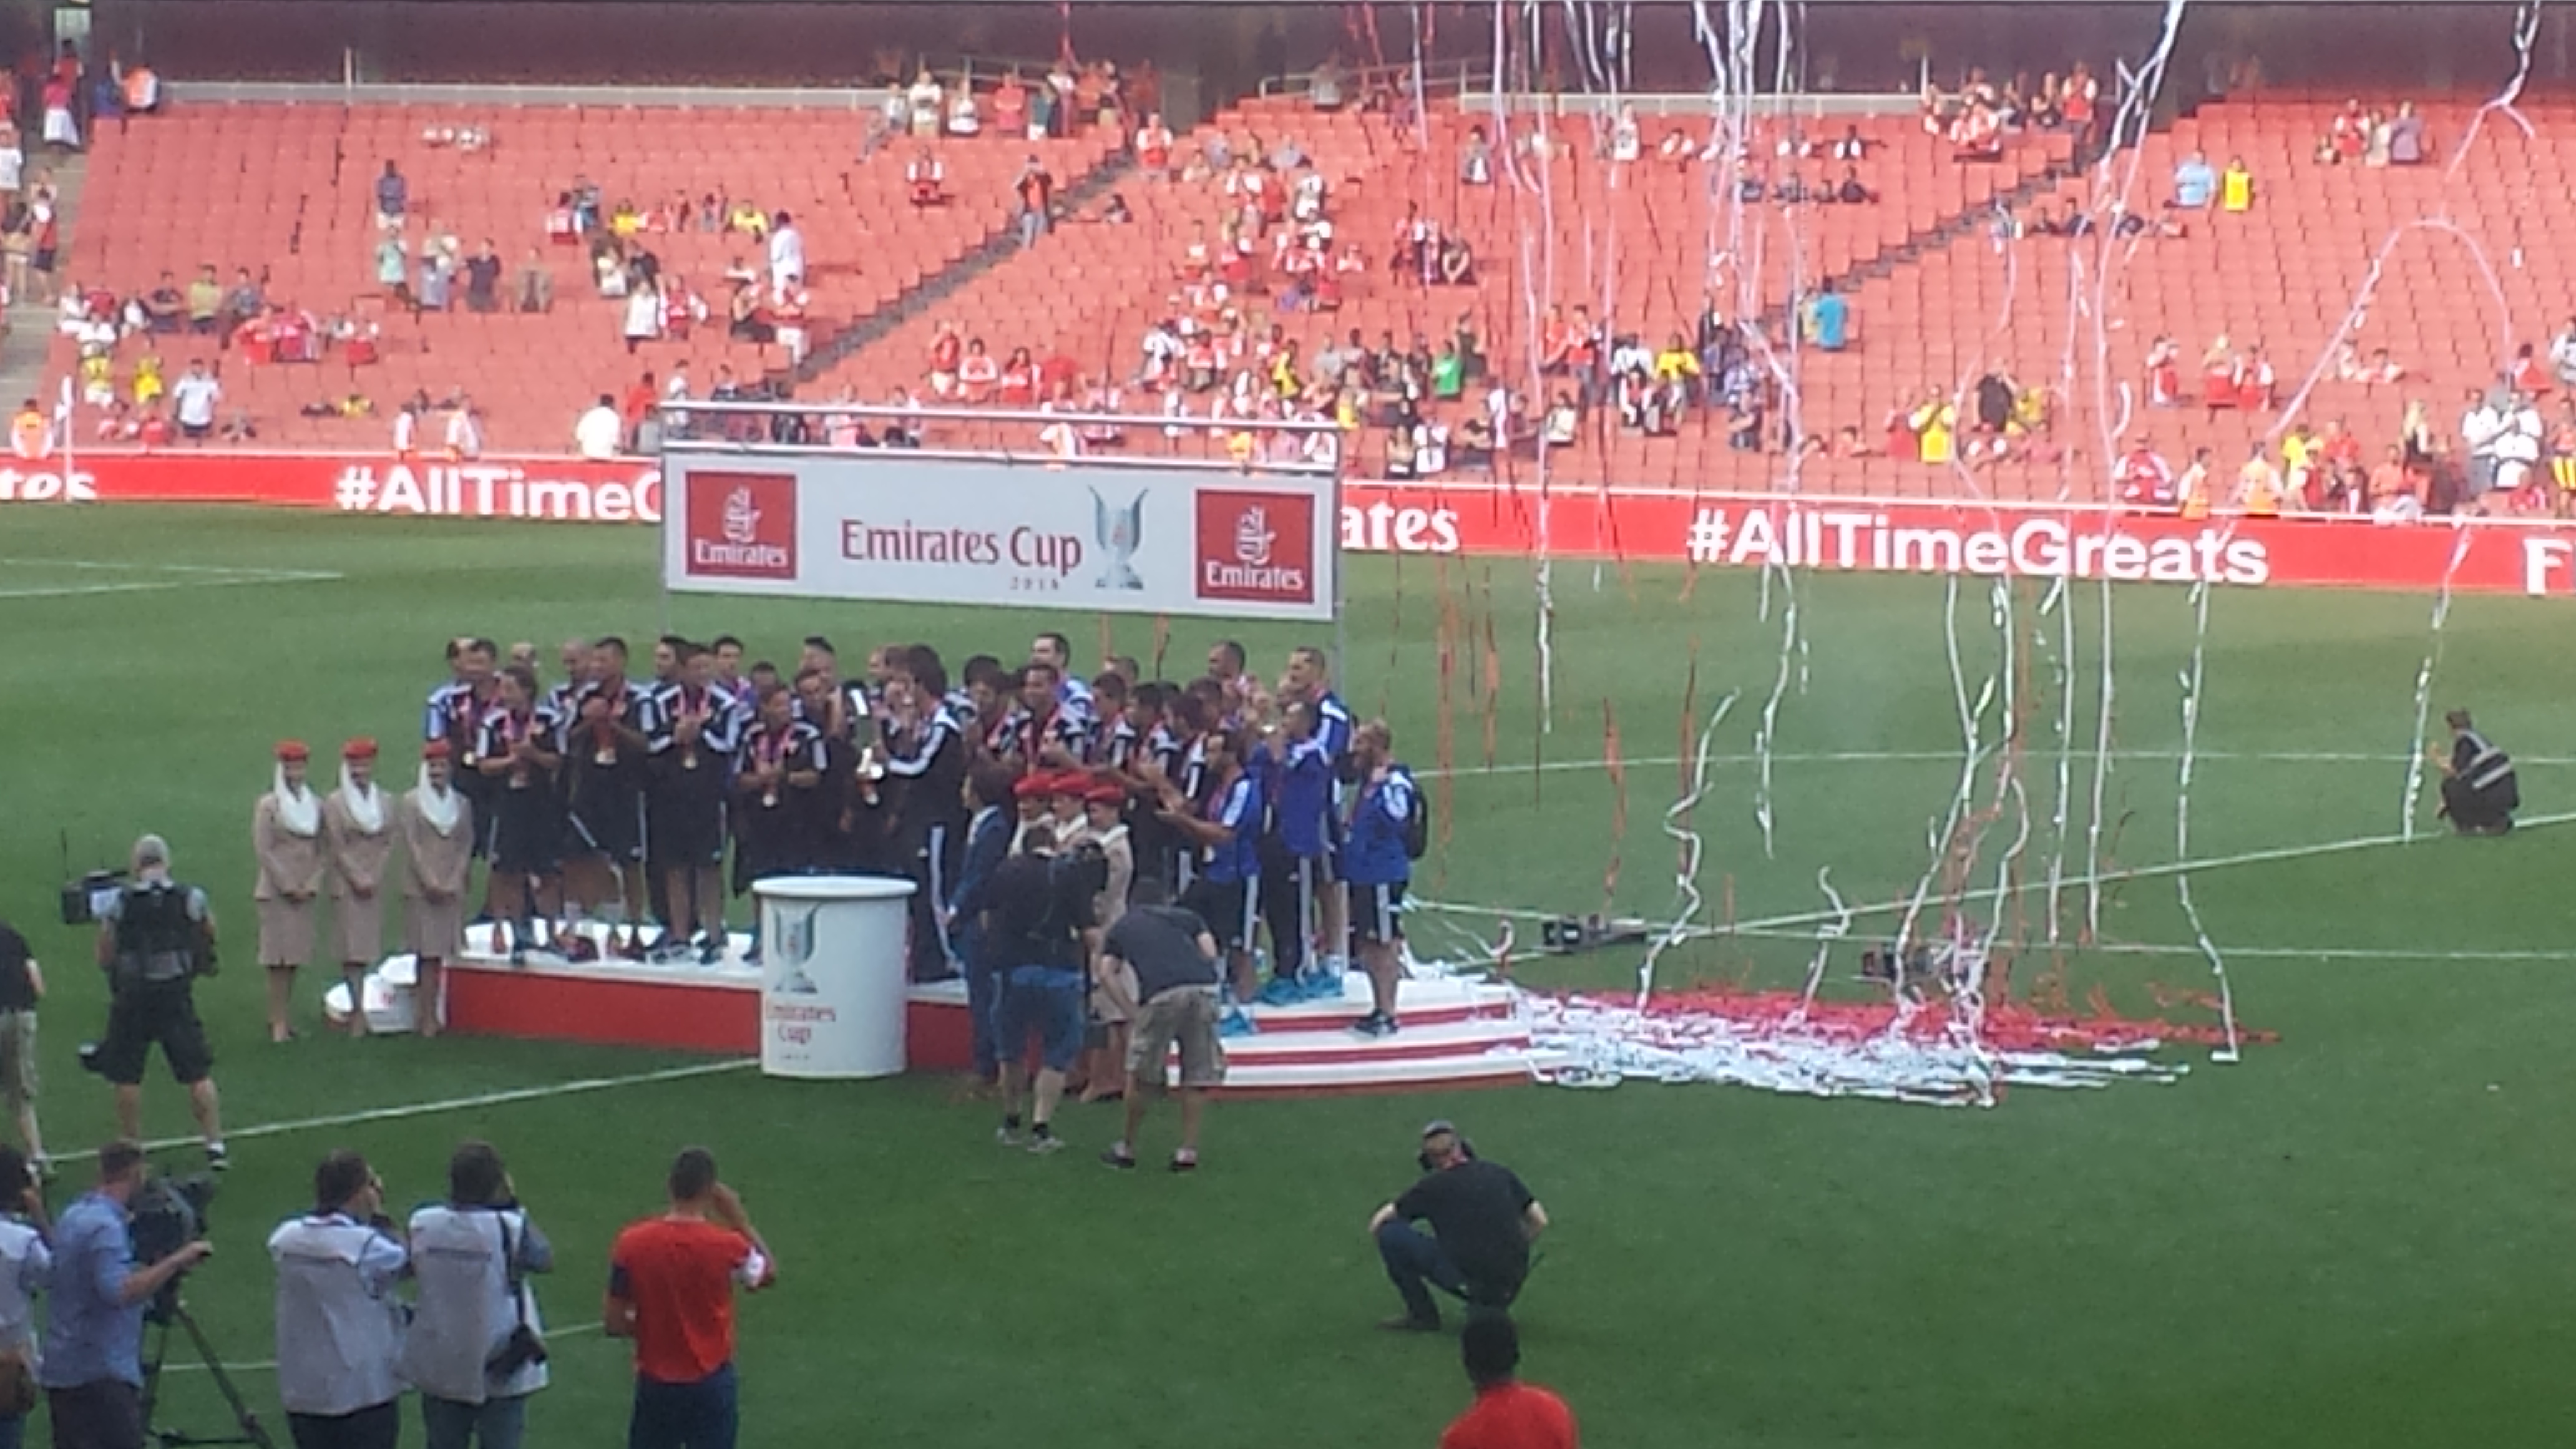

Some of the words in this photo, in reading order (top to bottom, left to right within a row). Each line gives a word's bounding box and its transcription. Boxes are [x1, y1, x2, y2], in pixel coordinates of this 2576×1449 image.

[694, 538, 788, 567] Emirates
[841, 519, 999, 565] Emirates
[1009, 526, 1081, 577] Cup
[1686, 507, 2269, 583] #AllTimeGreats
[1205, 560, 1304, 590] Emirates
